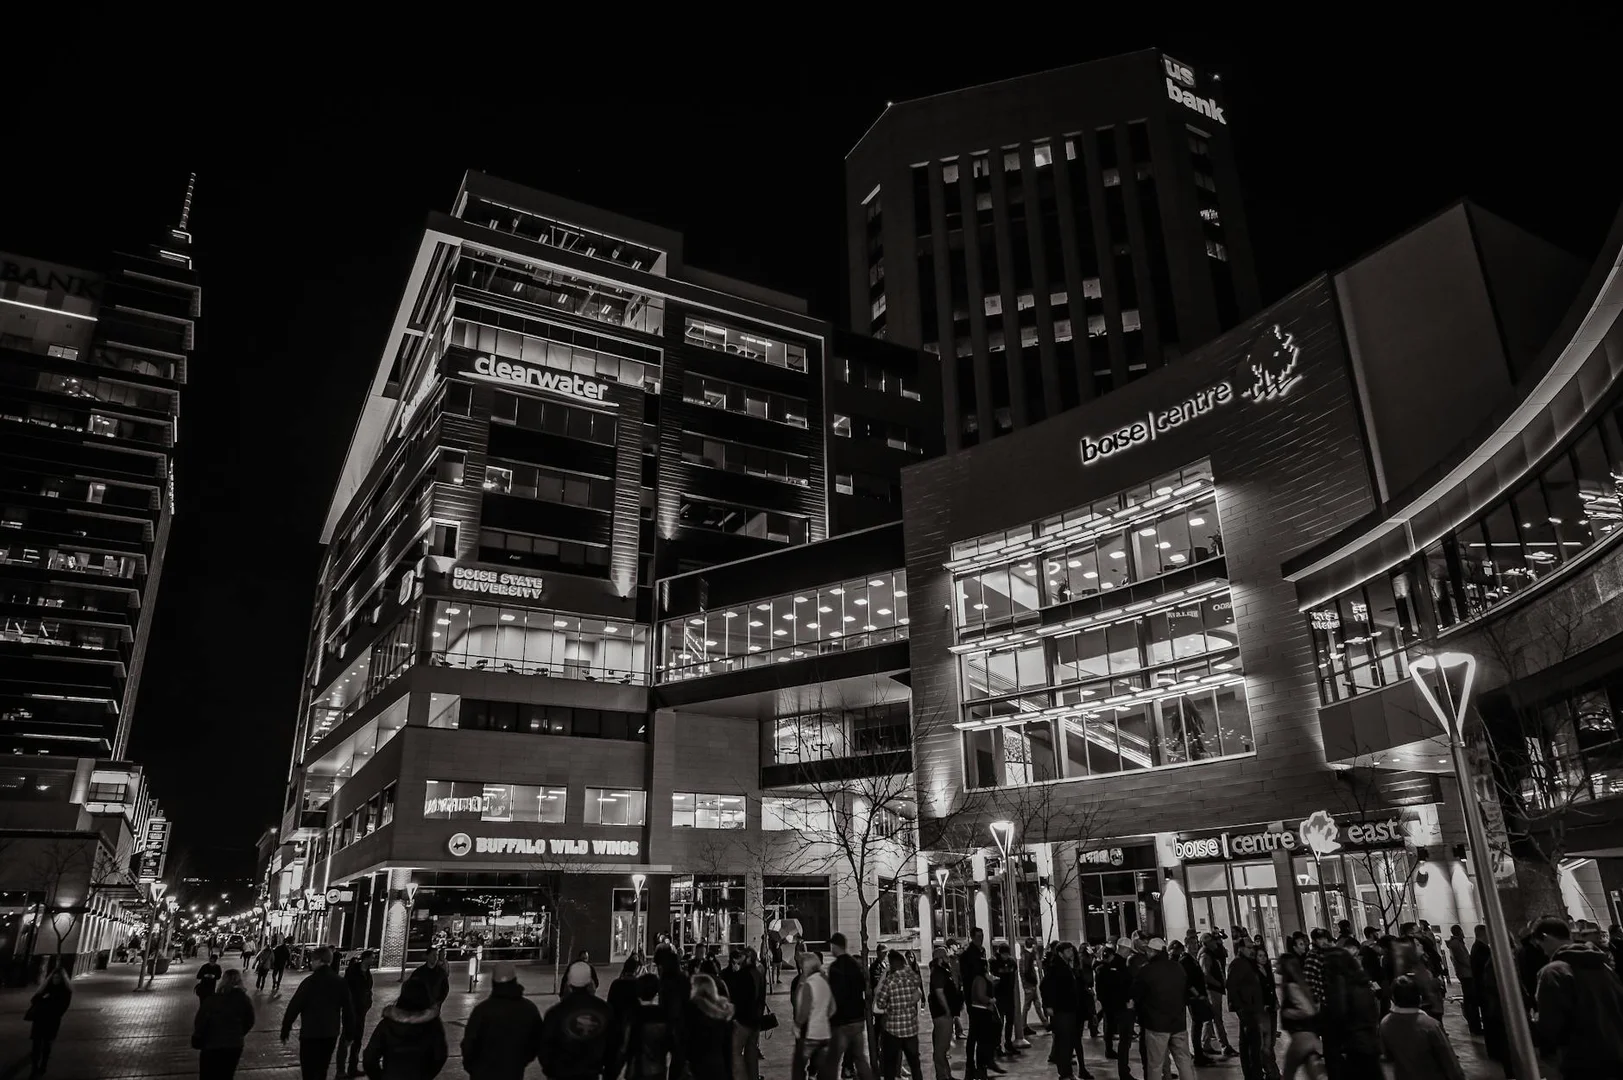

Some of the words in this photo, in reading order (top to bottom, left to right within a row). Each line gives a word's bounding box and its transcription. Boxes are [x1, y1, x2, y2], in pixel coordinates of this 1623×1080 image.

[1164, 59, 1195, 86] us
[1166, 77, 1227, 125] bank
[0, 261, 101, 300] BANK
[474, 354, 608, 400] clearwater
[1080, 421, 1147, 465] boise
[1156, 381, 1233, 432] centre
[453, 578, 542, 599] UNIVERSITY
[454, 567, 498, 583] BOISE
[500, 573, 543, 589] STATE
[475, 837, 546, 854] BUFFALO
[549, 838, 589, 855] WILD
[592, 840, 639, 856] WINGS
[1171, 837, 1219, 859] boise
[1231, 830, 1296, 854] centre
[1347, 818, 1402, 844] east
